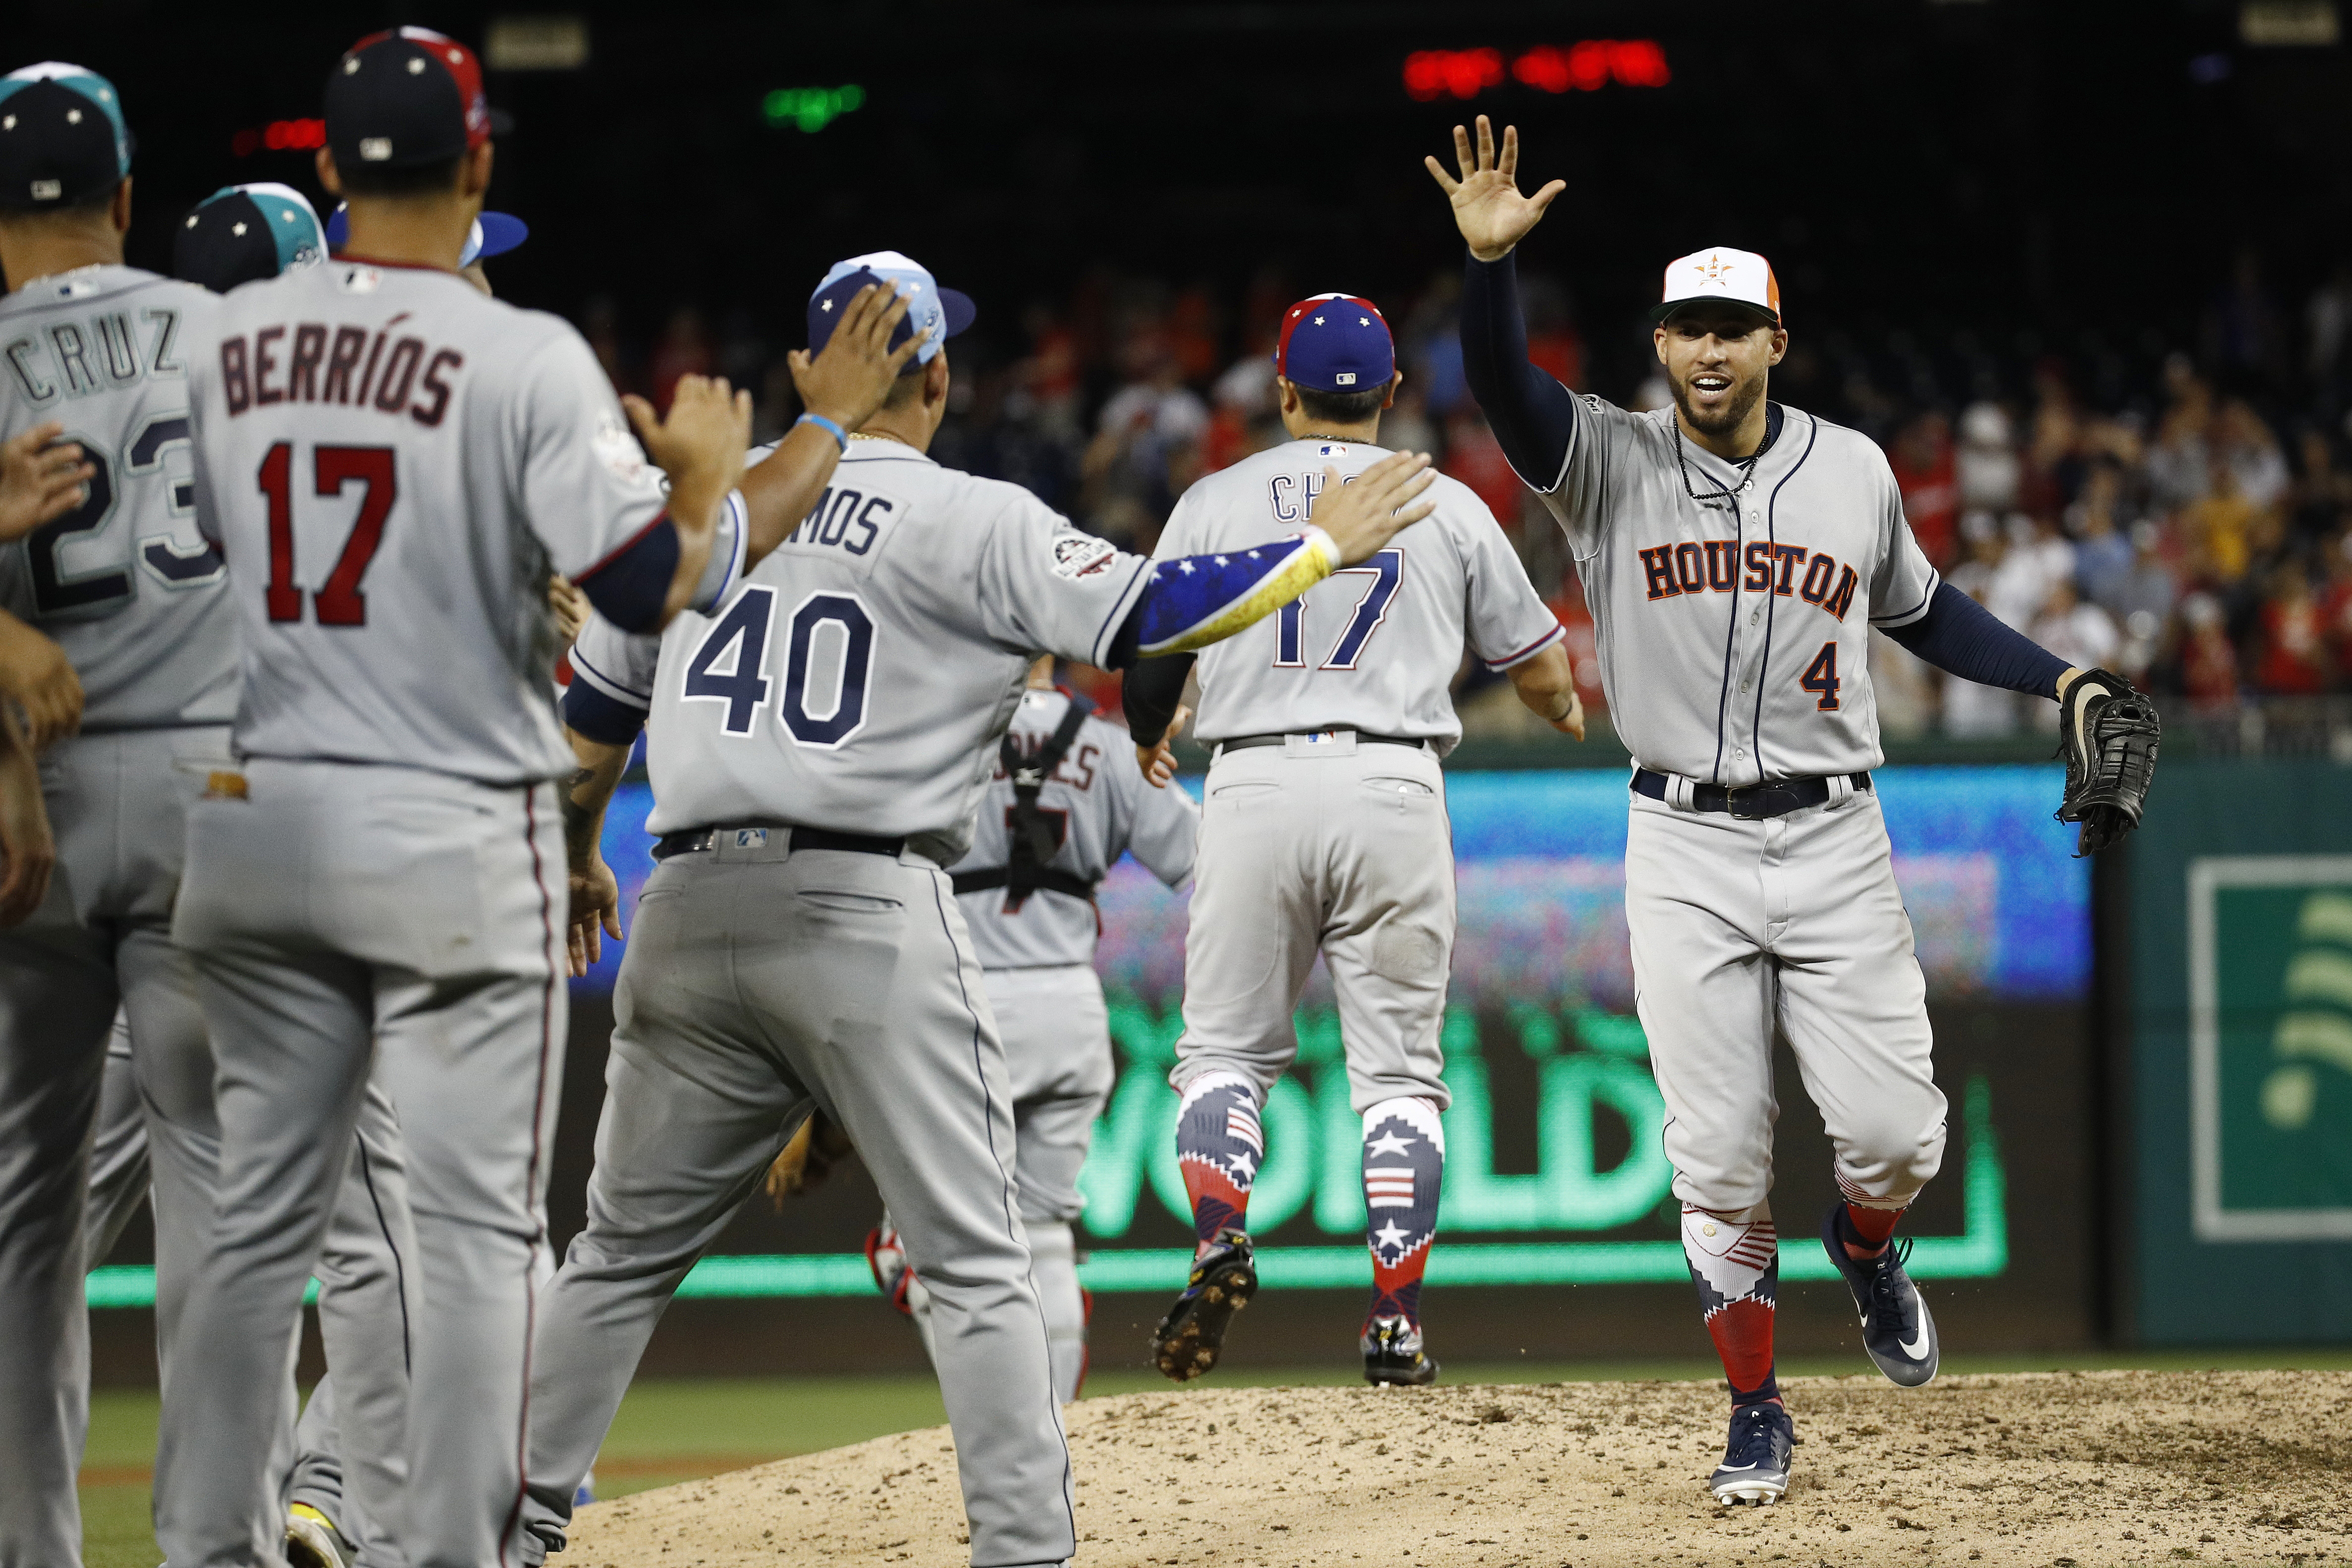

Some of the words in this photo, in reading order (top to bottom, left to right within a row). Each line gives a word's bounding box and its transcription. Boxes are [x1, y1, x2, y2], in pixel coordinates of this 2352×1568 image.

[4, 307, 186, 411] CRUZ
[220, 311, 463, 430] BERRÍOS
[22, 410, 227, 616] 23
[258, 440, 398, 627] 17
[789, 487, 892, 556] MOS
[1273, 547, 1404, 670] 17
[1638, 540, 1859, 623] HOUSTON
[680, 583, 879, 750] 40
[1799, 641, 1840, 711] 4
